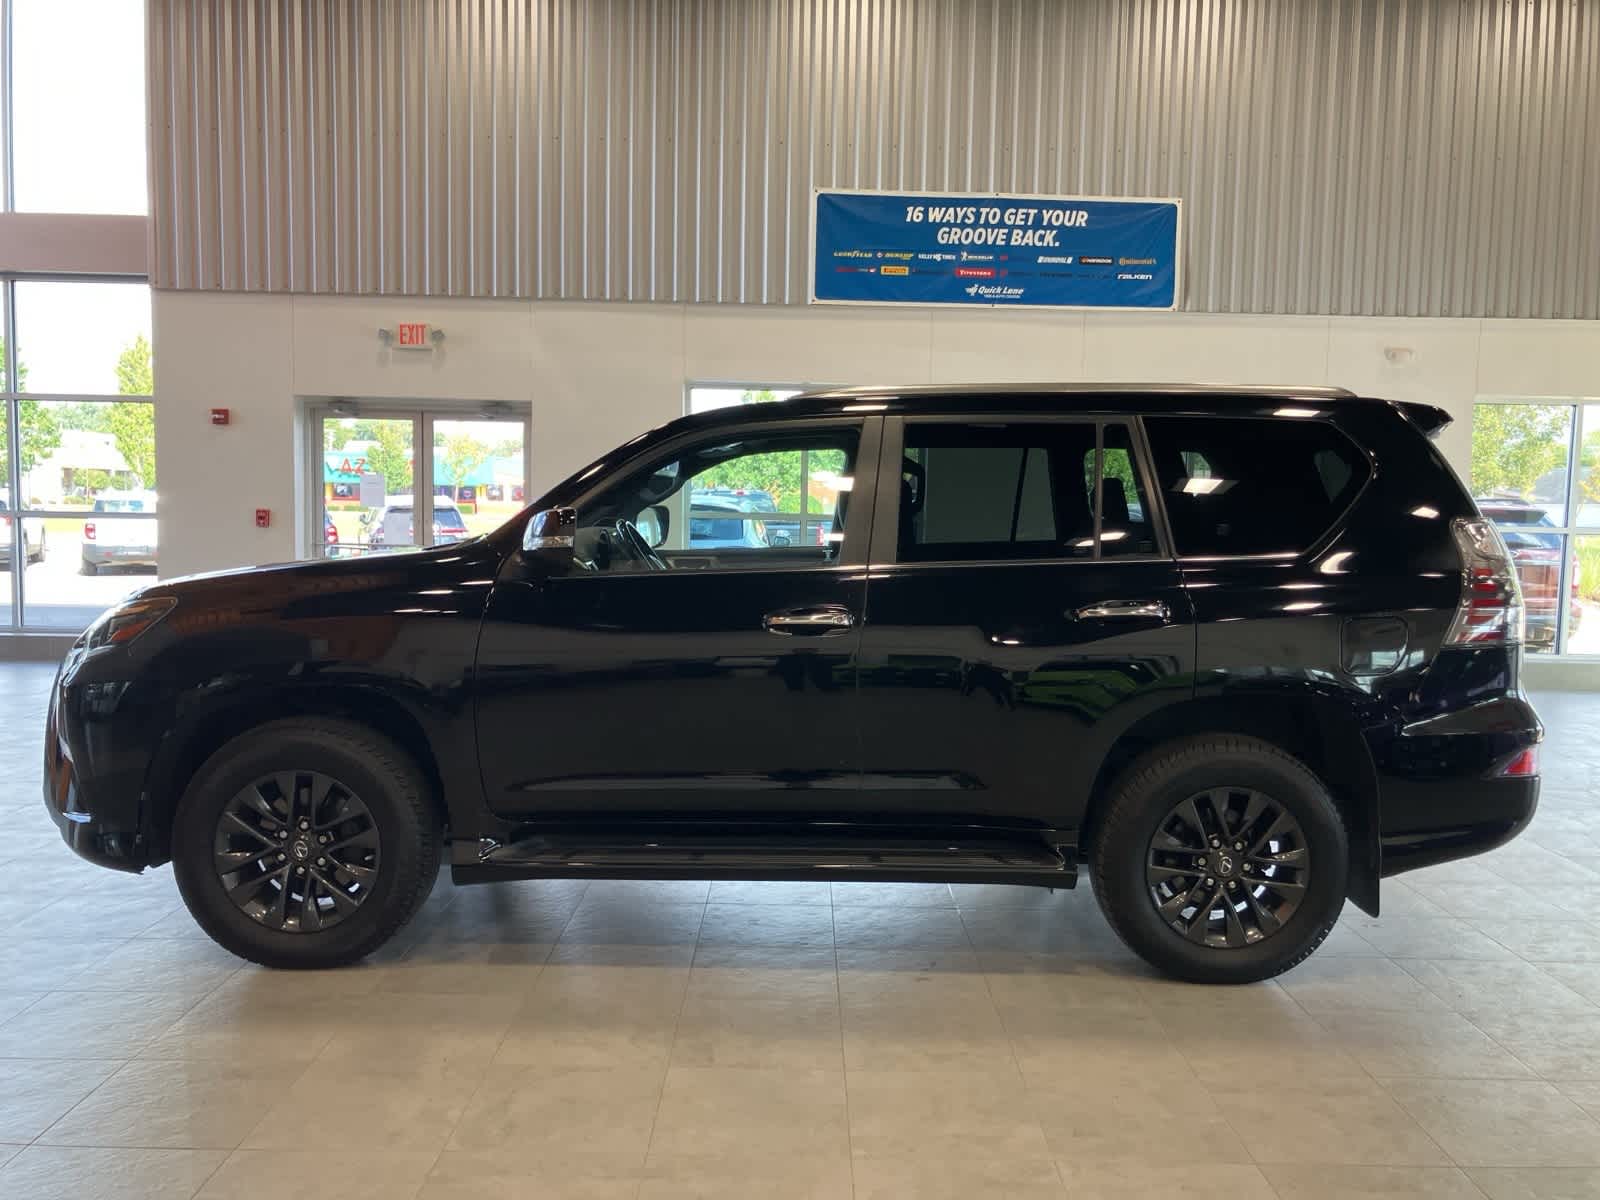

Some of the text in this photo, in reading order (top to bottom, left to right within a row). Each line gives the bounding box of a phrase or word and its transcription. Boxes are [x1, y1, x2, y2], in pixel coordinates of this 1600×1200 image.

[906, 206, 1089, 227] 16 WAYS TO GET YOUR
[937, 227, 1060, 247] GROOVE BACK.
[978, 285, 1024, 295] Quick Lane
[399, 323, 425, 345] EXIT
